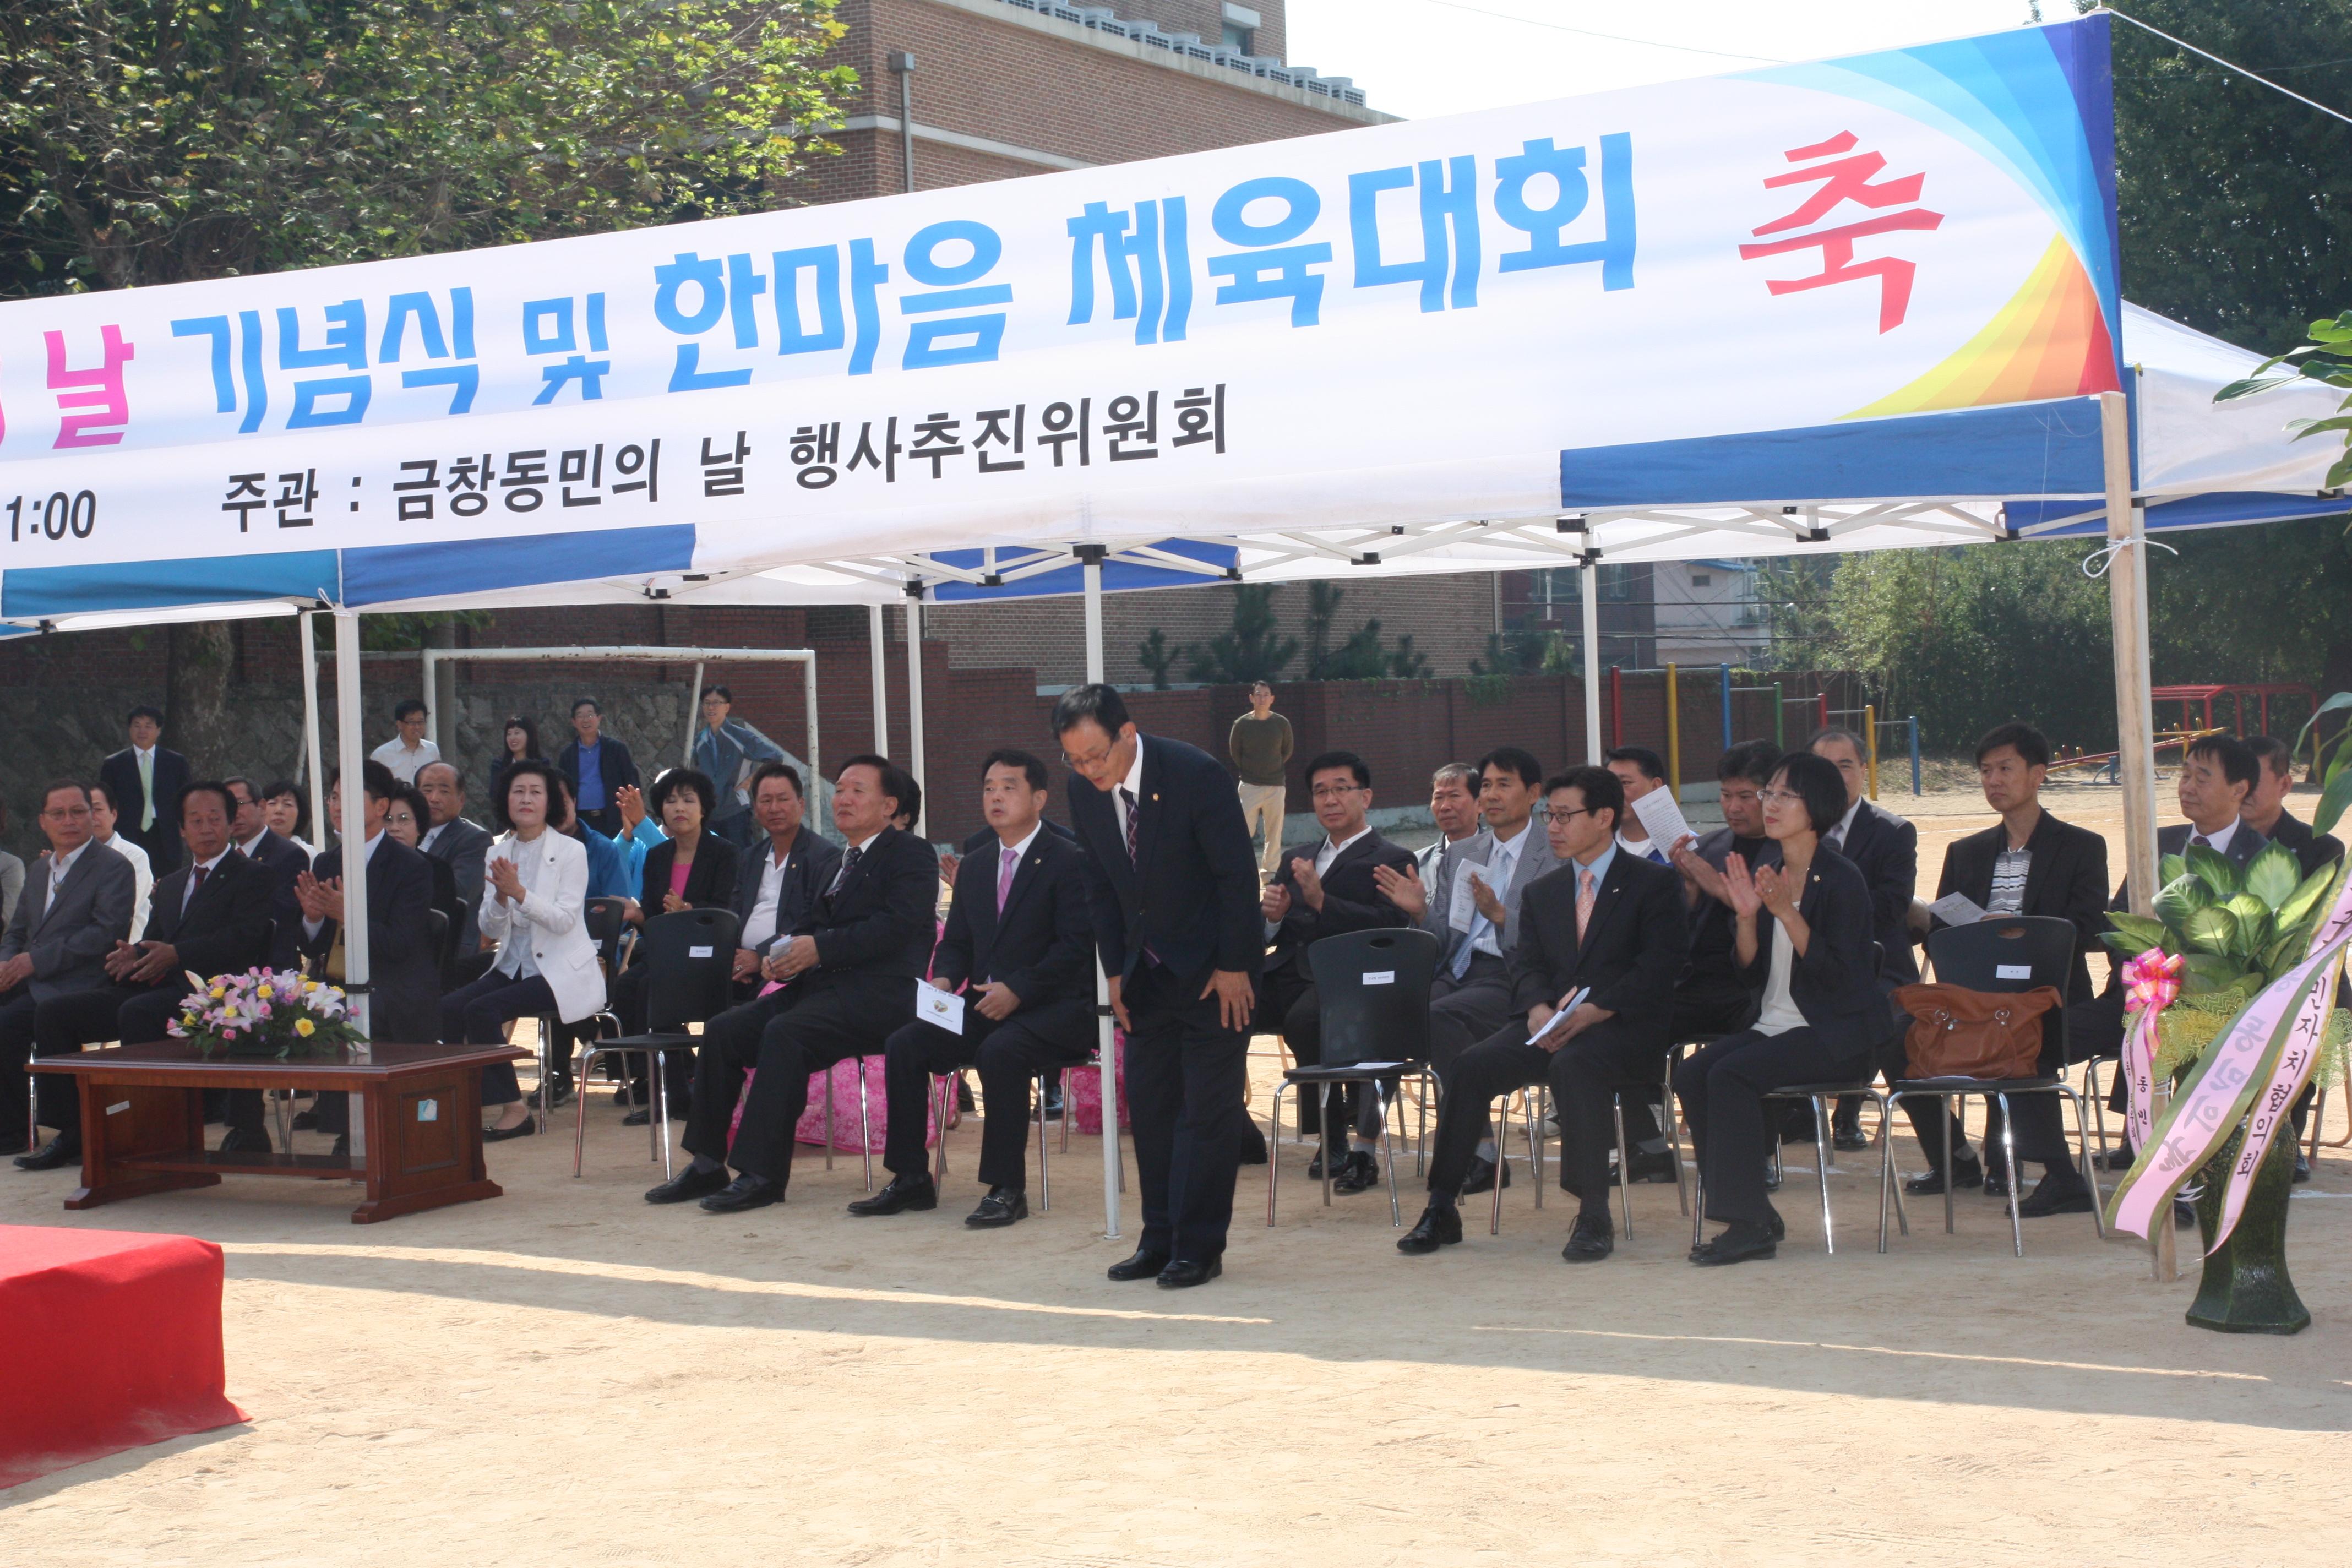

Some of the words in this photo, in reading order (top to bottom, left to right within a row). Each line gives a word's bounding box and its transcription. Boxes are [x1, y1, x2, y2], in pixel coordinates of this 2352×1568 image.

[43, 324, 134, 449] 날
[170, 287, 479, 434] 기념식
[523, 292, 611, 406] 및
[654, 220, 1013, 392] 한마음
[1066, 132, 1636, 345] 체육대회
[1738, 130, 1945, 335] 축
[221, 467, 319, 532] 주관
[393, 438, 661, 521] 금창동민의
[700, 430, 752, 497] 날
[789, 383, 1227, 489] 행사추진위원회
